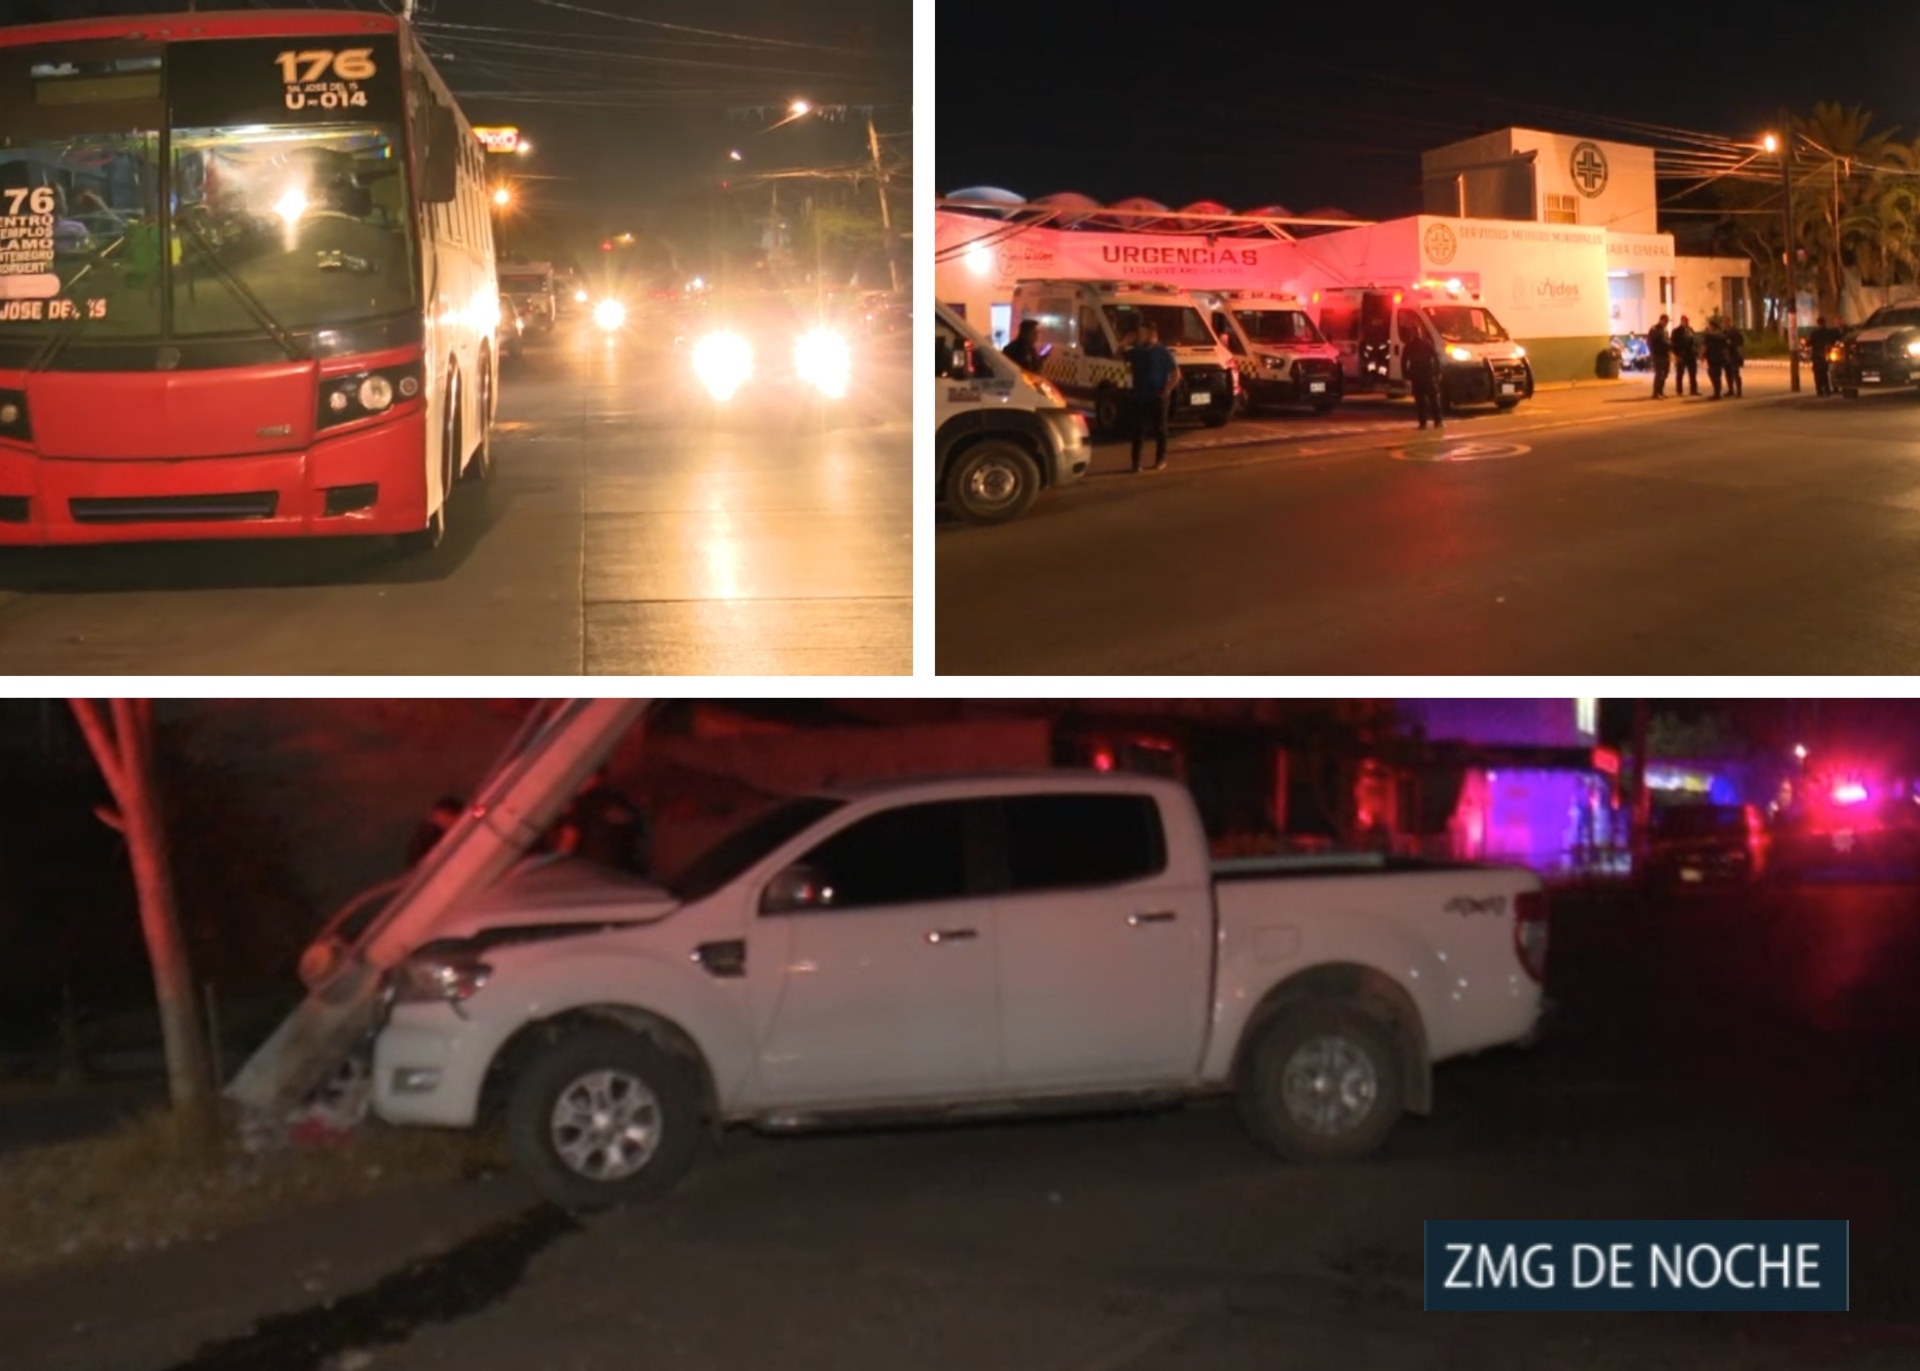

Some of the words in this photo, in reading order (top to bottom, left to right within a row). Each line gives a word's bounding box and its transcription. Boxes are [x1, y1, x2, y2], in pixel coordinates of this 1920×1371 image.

[275, 48, 377, 84] 176
[285, 91, 369, 110] U-014
[4, 186, 55, 216] 76
[1102, 245, 1258, 266] URGENCIAS
[0, 301, 42, 320] JOSE
